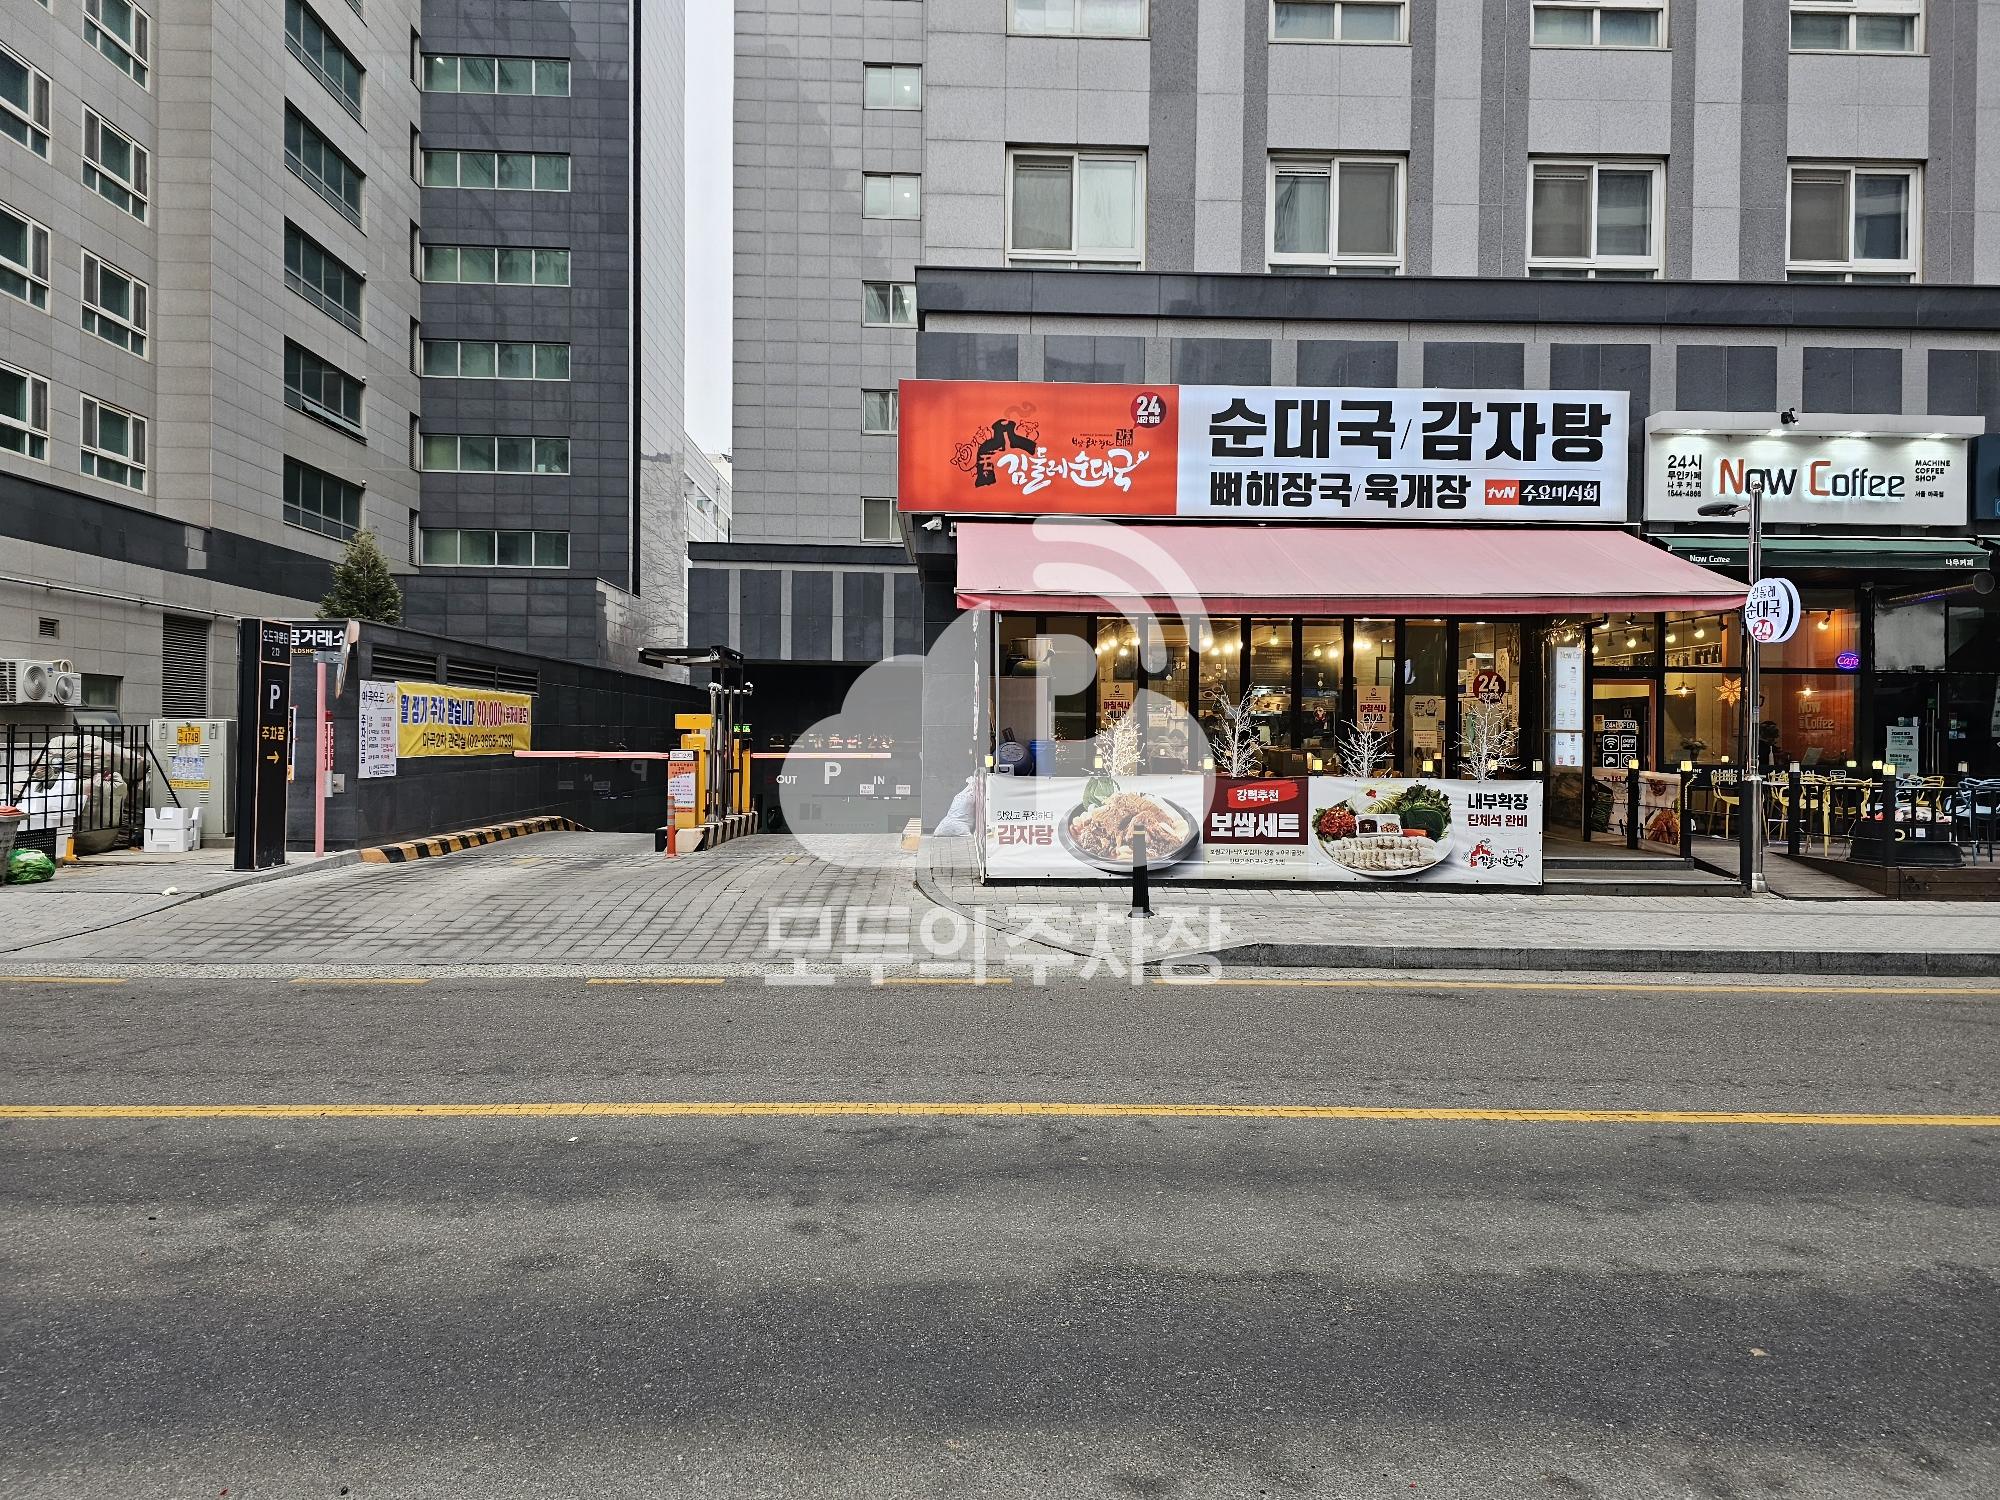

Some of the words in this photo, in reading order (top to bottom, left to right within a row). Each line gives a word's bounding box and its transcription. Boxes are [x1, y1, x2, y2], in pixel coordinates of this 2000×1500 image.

[1136, 395, 1160, 416] 24
[1668, 454, 1702, 470] 24시
[1667, 471, 1702, 481] 무인카페
[1719, 459, 1798, 496] Now
[1809, 460, 1905, 497] Coffee
[1486, 486, 1517, 499] tvN
[1521, 483, 1598, 502] 수요미식회
[1709, 555, 1731, 563] Coffee
[1945, 558, 1974, 567] 나우커피
[1746, 599, 1780, 619] 순대국
[1754, 622, 1771, 636] 24
[1837, 656, 1859, 666] Cafe
[1478, 675, 1500, 692] 24
[269, 684, 281, 710] P
[261, 726, 285, 741] 주차장
[775, 774, 798, 785] OUT
[824, 761, 842, 785] P
[873, 775, 885, 785] IN
[1236, 788, 1279, 802] 강력추천
[1468, 793, 1529, 810] 내부확장
[996, 811, 1021, 821] 맛있고
[1022, 811, 1054, 821] 푸짐하다
[1468, 814, 1501, 827] 단체석
[1505, 814, 1528, 827] 완비
[1210, 812, 1300, 837] 보쌈세트
[997, 824, 1054, 846] 감자탕
